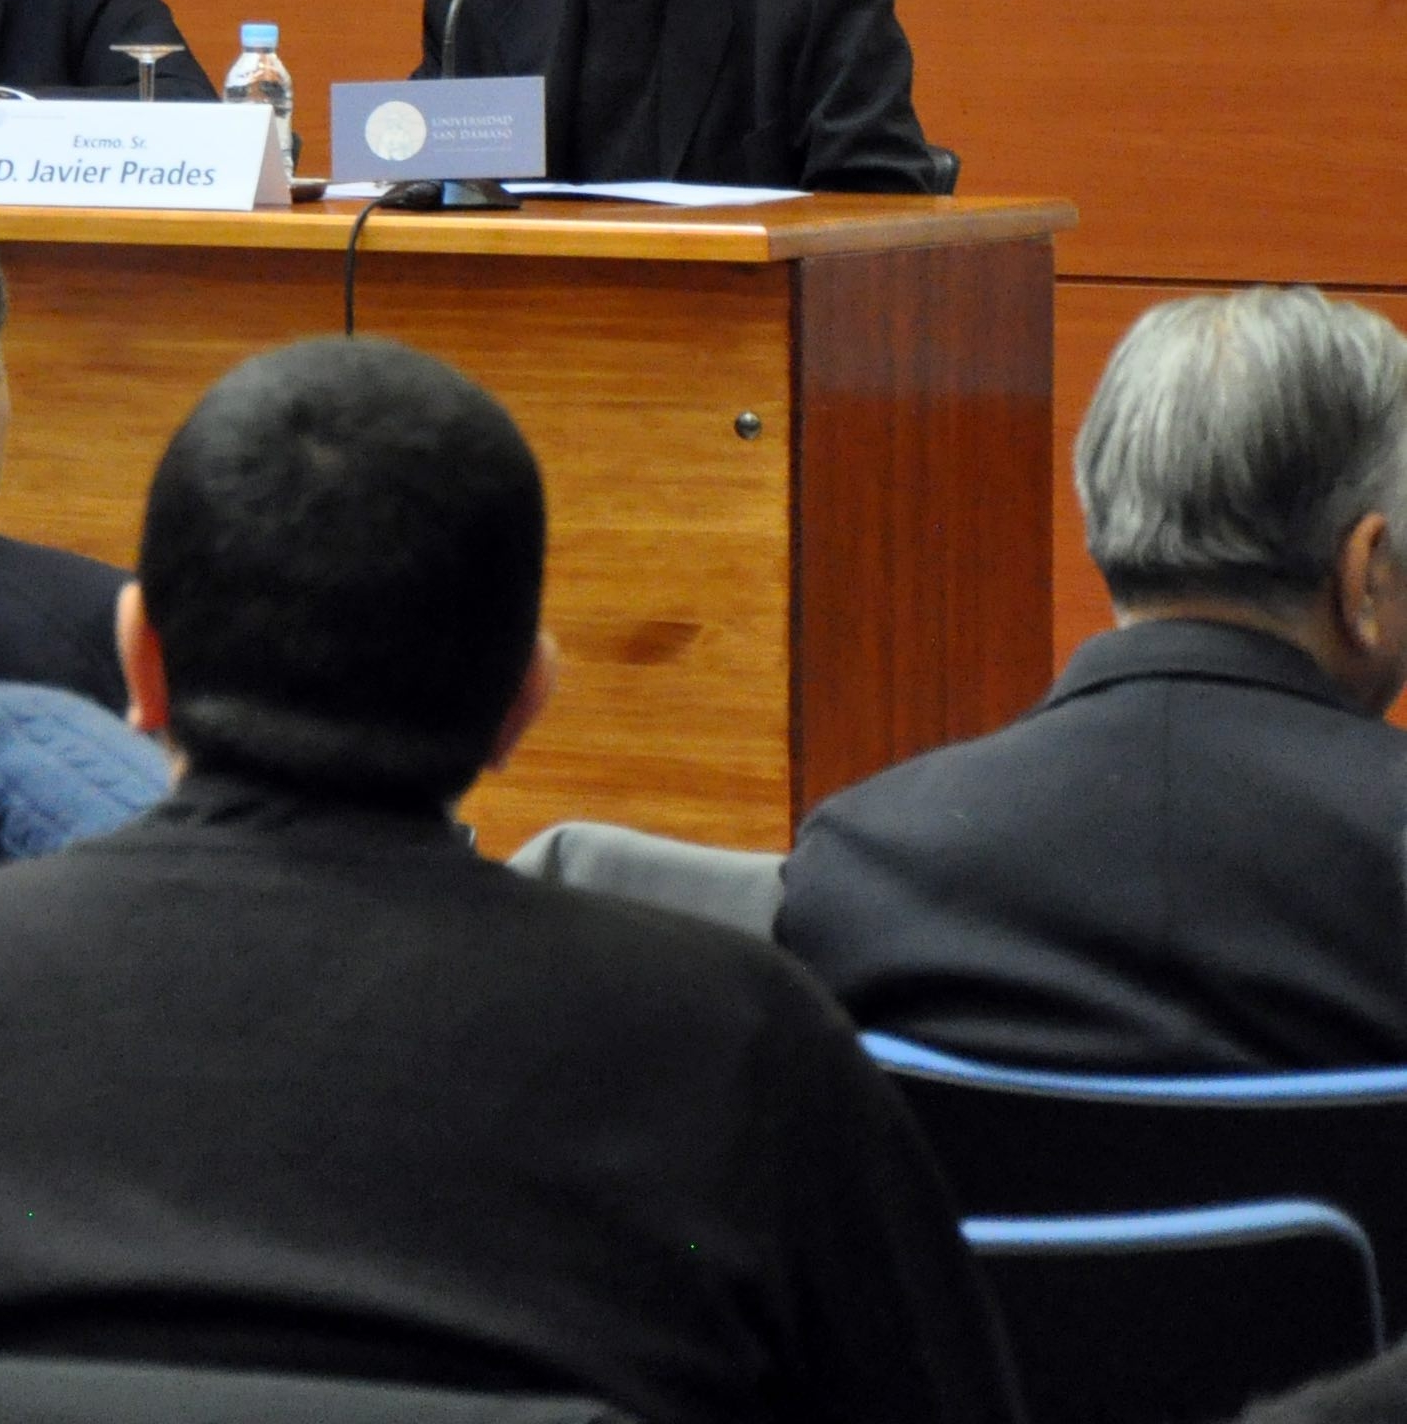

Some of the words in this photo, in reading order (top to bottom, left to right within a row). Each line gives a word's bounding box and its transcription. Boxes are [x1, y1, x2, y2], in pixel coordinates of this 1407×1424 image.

[73, 134, 125, 149] Excmo.
[131, 135, 148, 150] Sr.
[27, 158, 112, 184] Javier
[120, 160, 216, 186] Prades
